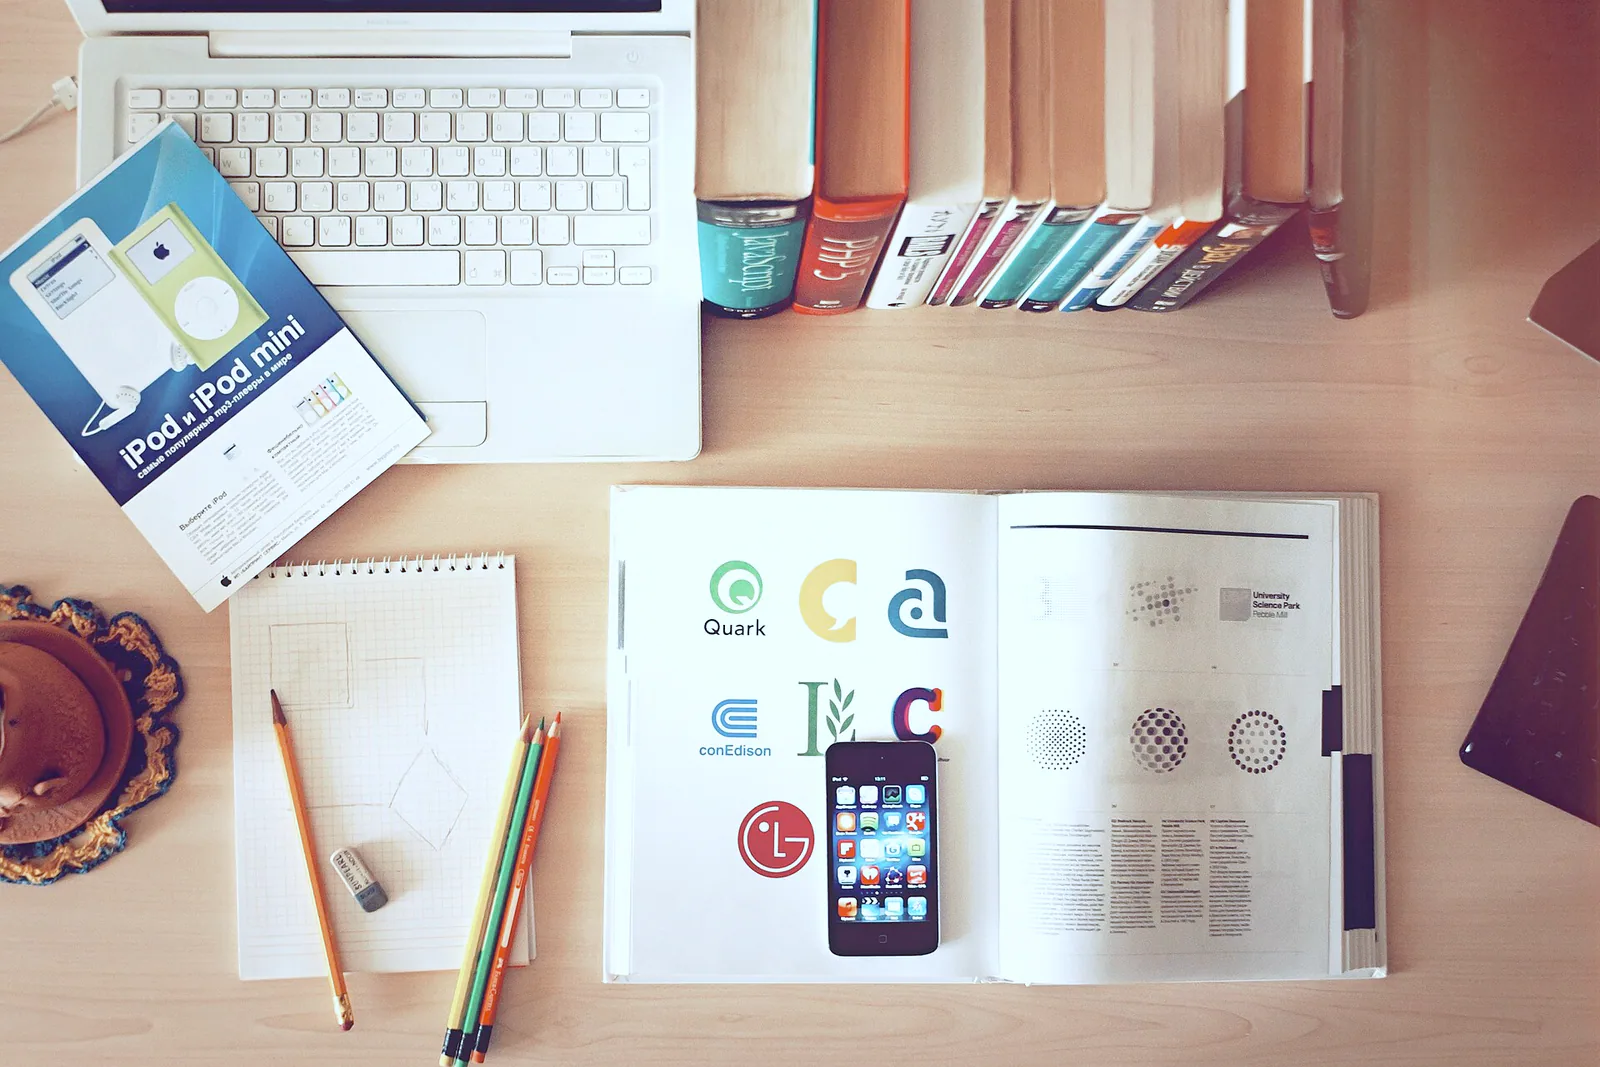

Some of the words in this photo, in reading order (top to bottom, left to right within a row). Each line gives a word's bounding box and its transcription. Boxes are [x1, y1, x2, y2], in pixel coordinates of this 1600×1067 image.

[729, 231, 789, 292] JavaScript
[118, 412, 182, 470] iPod
[181, 411, 196, 425] и
[189, 357, 252, 414] iPod
[249, 314, 306, 368] mini
[136, 453, 165, 479] самые
[164, 415, 215, 457] популярные
[213, 375, 264, 417] mp3-плееры
[263, 369, 271, 377] в
[270, 352, 292, 371] мире
[178, 502, 212, 531] Выберите
[211, 490, 227, 504] iPod
[1252, 601, 1282, 609] Science
[1253, 591, 1290, 601] University
[1253, 610, 1275, 618] Pebble
[704, 618, 766, 637] Quark
[699, 744, 771, 757] conEdison
